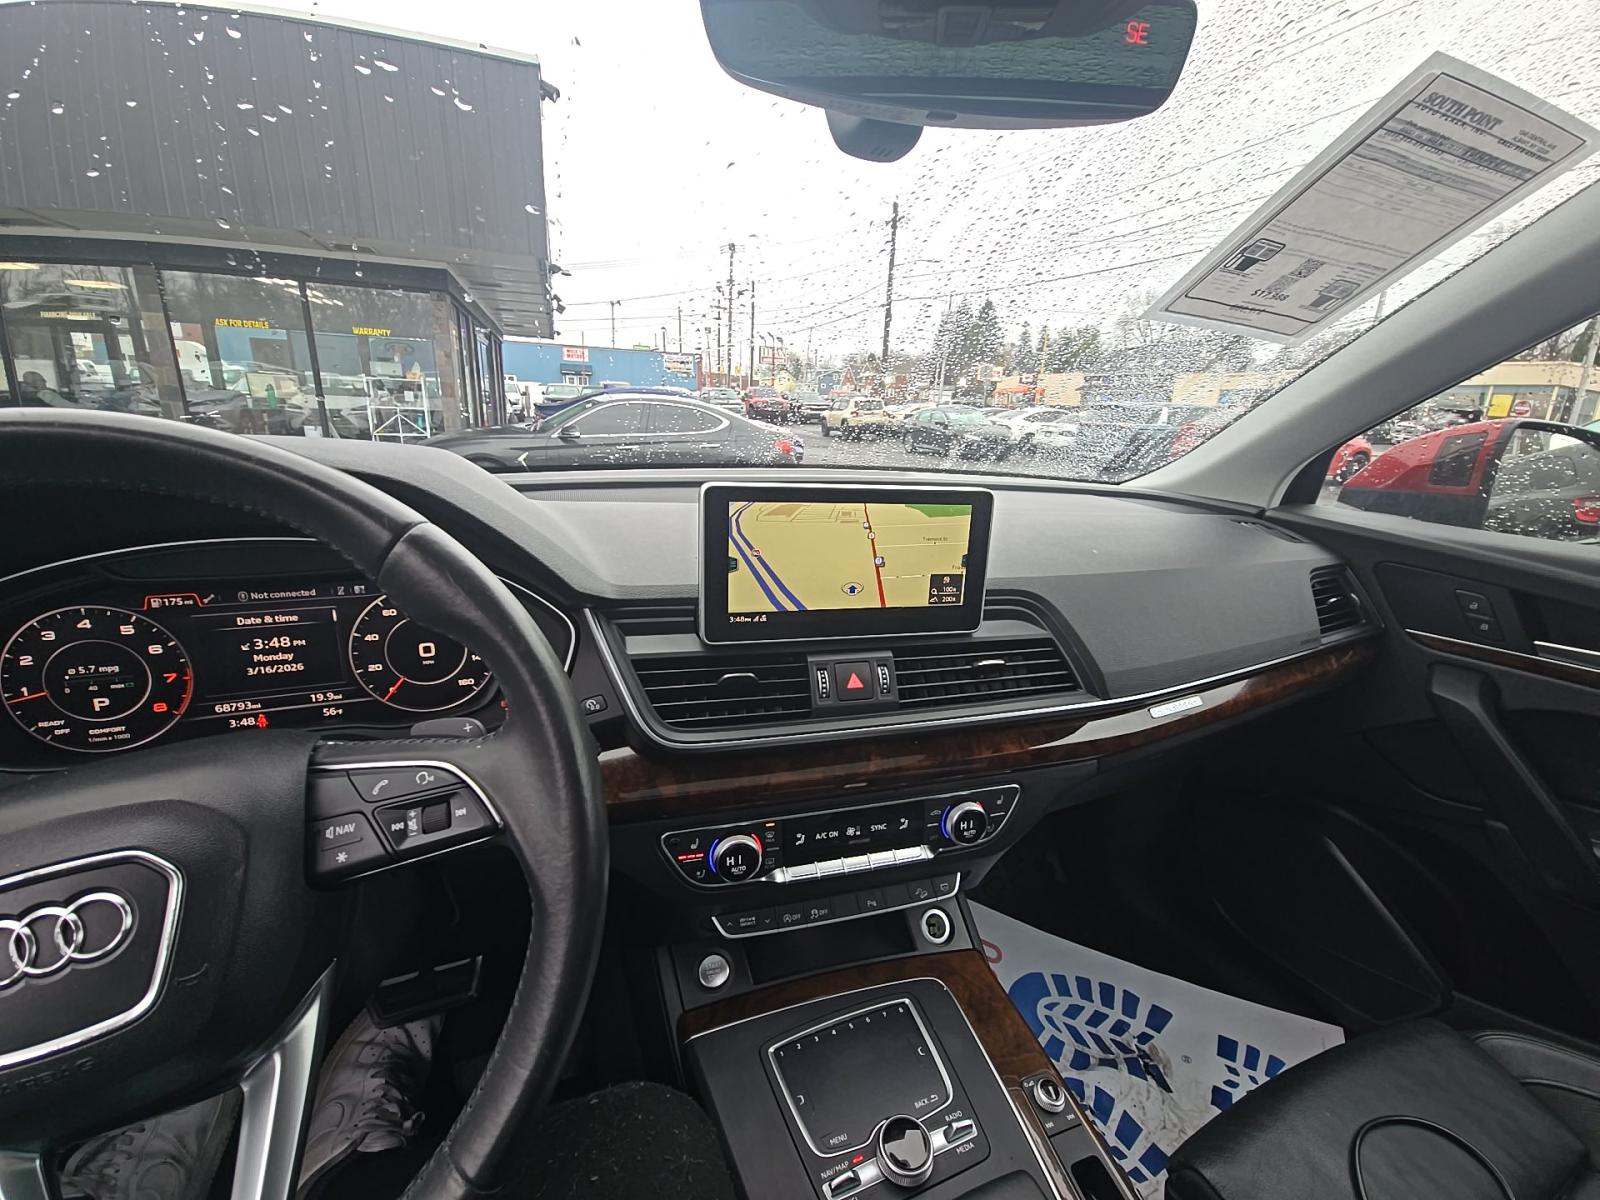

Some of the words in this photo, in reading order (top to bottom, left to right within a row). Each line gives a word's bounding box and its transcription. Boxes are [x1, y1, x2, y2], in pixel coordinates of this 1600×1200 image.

[1126, 19, 1151, 45] SE
[1423, 91, 1469, 117] SOUTH
[1461, 106, 1503, 131] POINT
[215, 318, 229, 327] ASK
[230, 319, 242, 328] FOR
[243, 320, 269, 329] DETAILS
[352, 326, 391, 337] WARRANTY
[250, 590, 270, 601] Not
[269, 587, 317, 599] connected
[164, 598, 183, 606] 175
[76, 619, 92, 629] 4
[236, 616, 262, 626] Date
[263, 615, 273, 624] &
[274, 614, 299, 624] time
[119, 625, 135, 635] 5
[40, 631, 56, 641] 3
[364, 633, 379, 642] 40
[252, 636, 292, 651] 3:48
[148, 645, 163, 655] 6
[19, 655, 34, 666] 2
[252, 652, 294, 662] Monday
[78, 665, 96, 674] 5.7
[98, 665, 120, 674] mpg
[246, 662, 305, 676] 3/16/2026
[367, 664, 383, 672] 20
[163, 673, 177, 683] 7
[20, 686, 29, 697] 1
[92, 697, 110, 712] P
[153, 703, 168, 712] 8
[38, 719, 65, 728] READY
[228, 717, 256, 729] 3:48
[88, 726, 126, 735] COMFORT
[335, 822, 357, 837] NAV
[870, 823, 888, 832] SYNC
[815, 832, 828, 840] A/C
[828, 830, 839, 839] ON
[731, 865, 747, 873] AUTO
[914, 1098, 929, 1109] BACK
[944, 1110, 963, 1122] RADIO
[829, 1133, 848, 1146] MENU
[956, 1141, 975, 1154] MEDIA
[821, 1160, 849, 1179] NAV/MAP
